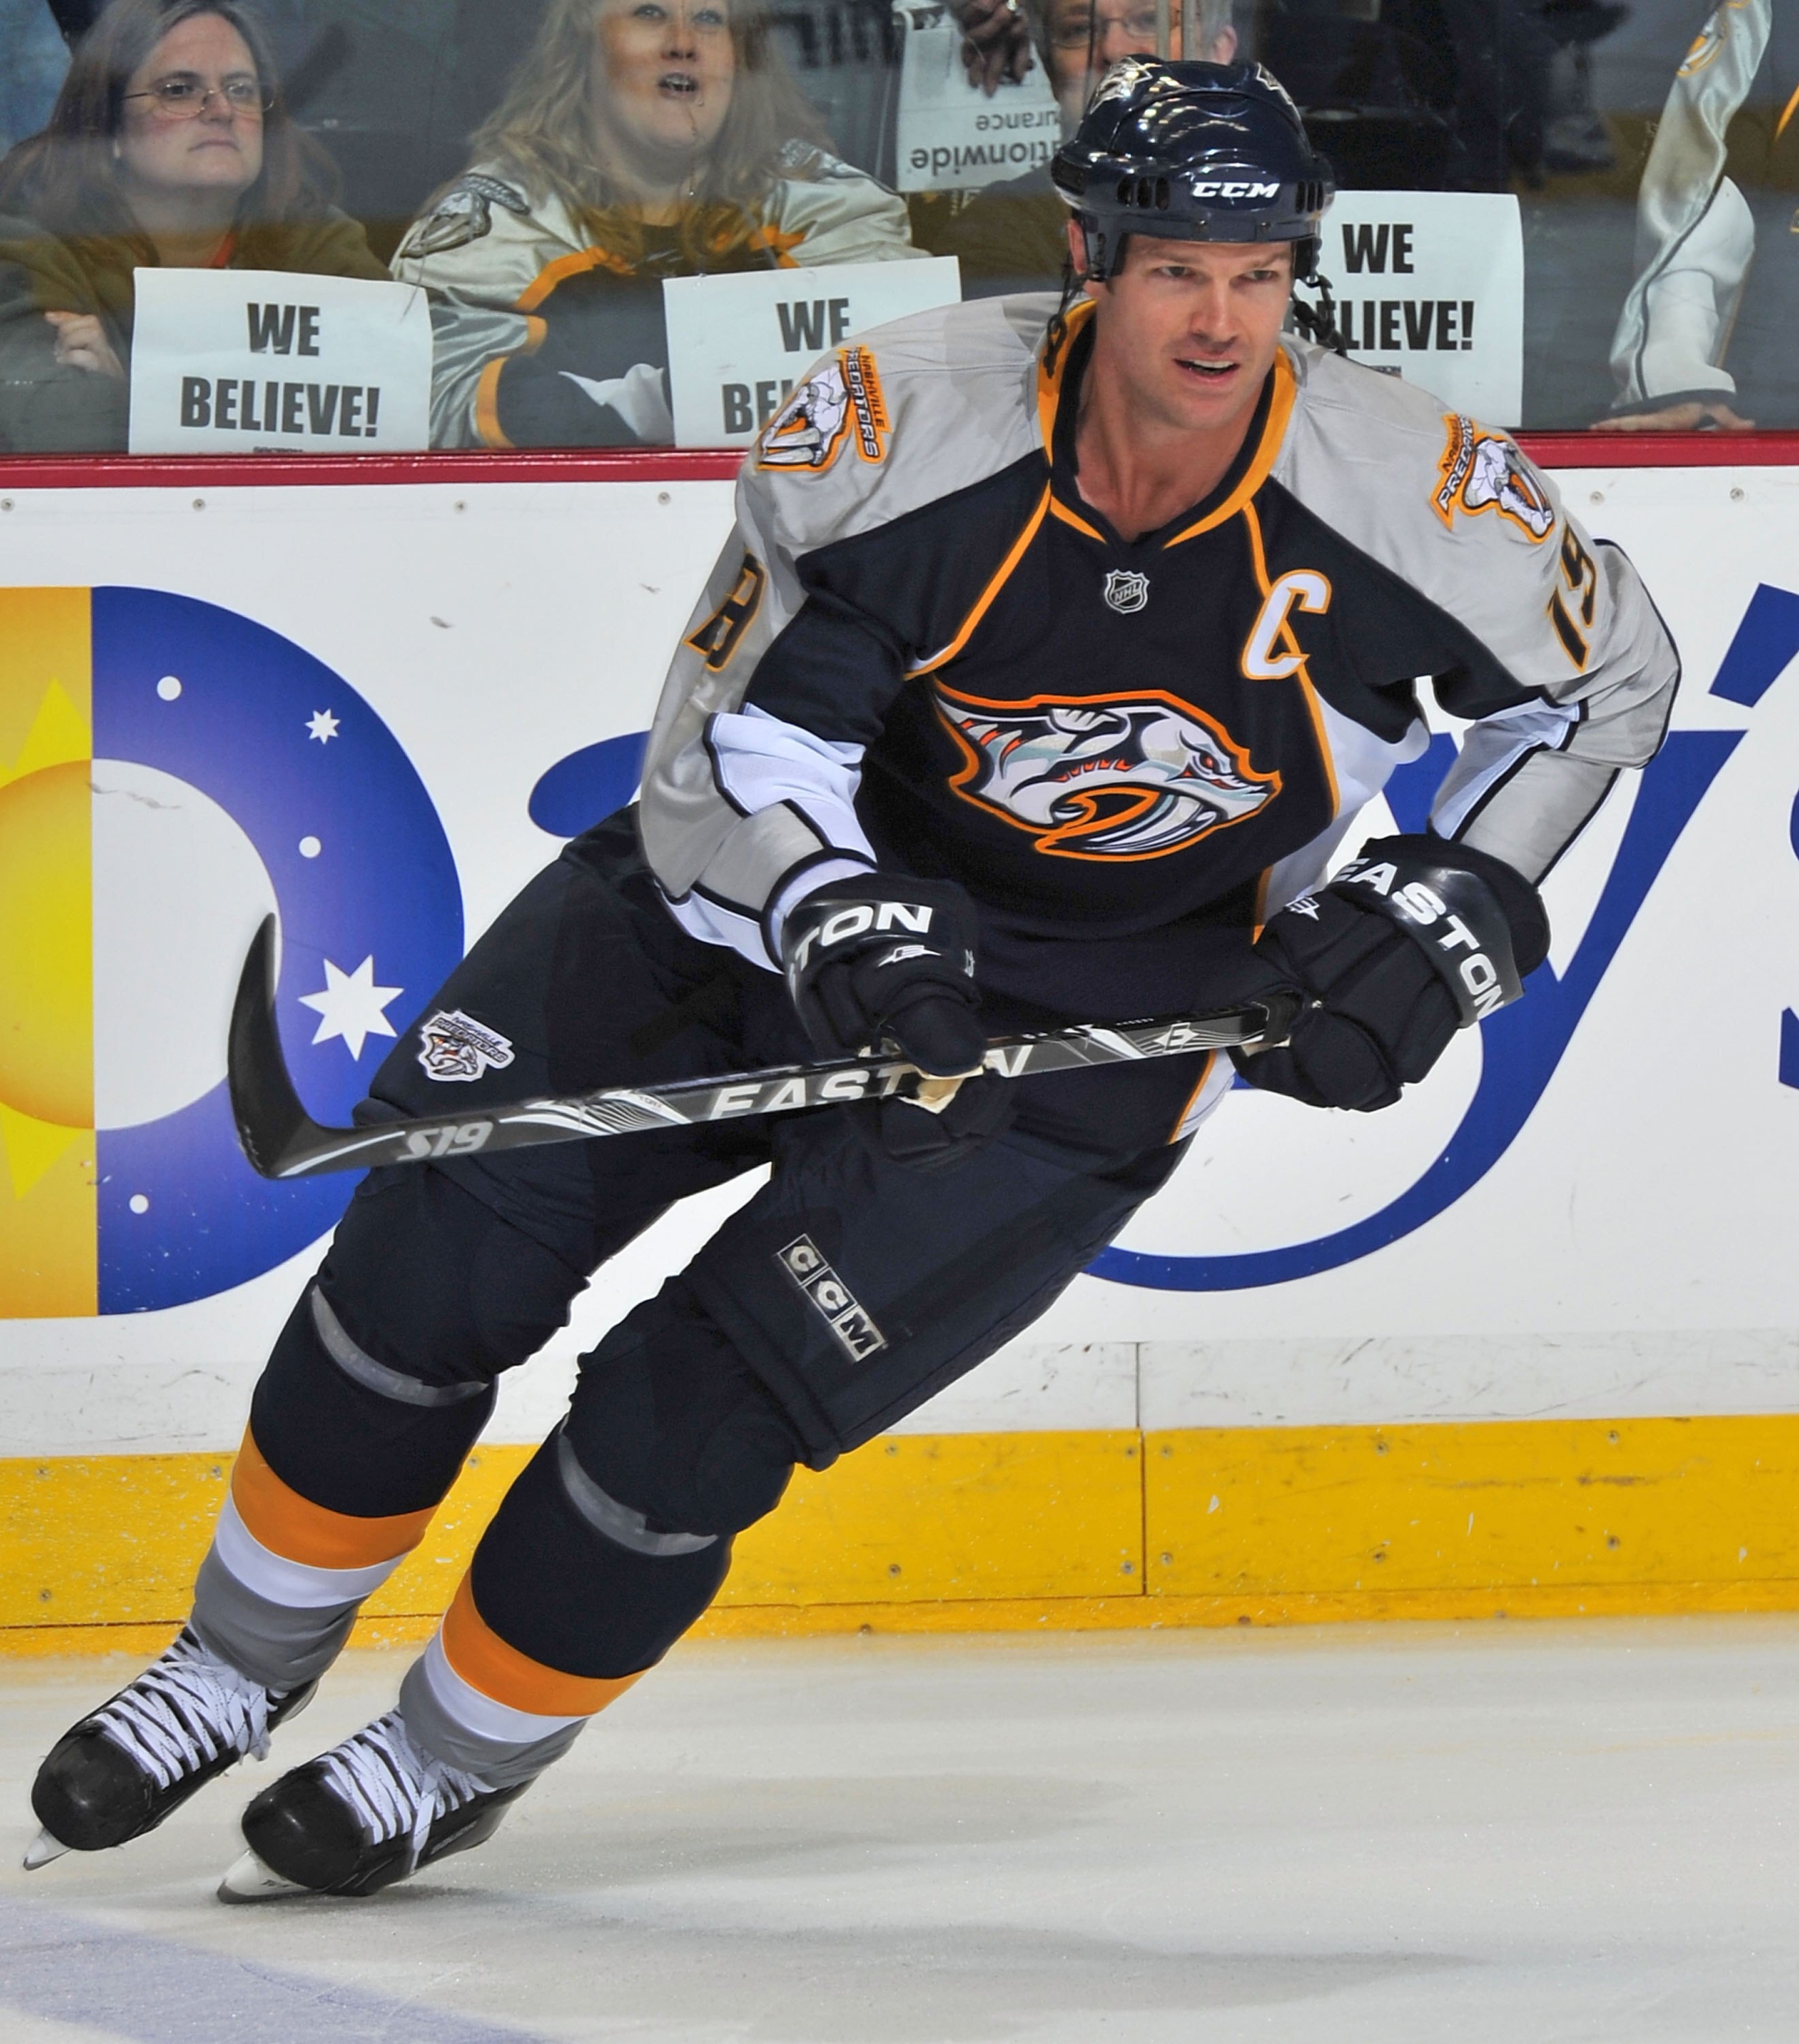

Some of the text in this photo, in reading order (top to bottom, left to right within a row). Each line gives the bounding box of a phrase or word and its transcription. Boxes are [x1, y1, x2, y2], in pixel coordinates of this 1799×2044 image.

[1192, 182, 1280, 198] CCM
[1343, 223, 1413, 273] WE
[247, 303, 319, 355] WE
[776, 298, 849, 352] WE
[181, 377, 379, 437] BELIEVE!
[1114, 585, 1141, 602] NHL
[1241, 569, 1332, 680] C
[430, 1017, 508, 1063] PREDATORS
[396, 1121, 494, 1160] S19
[783, 1240, 881, 1357] CCM
